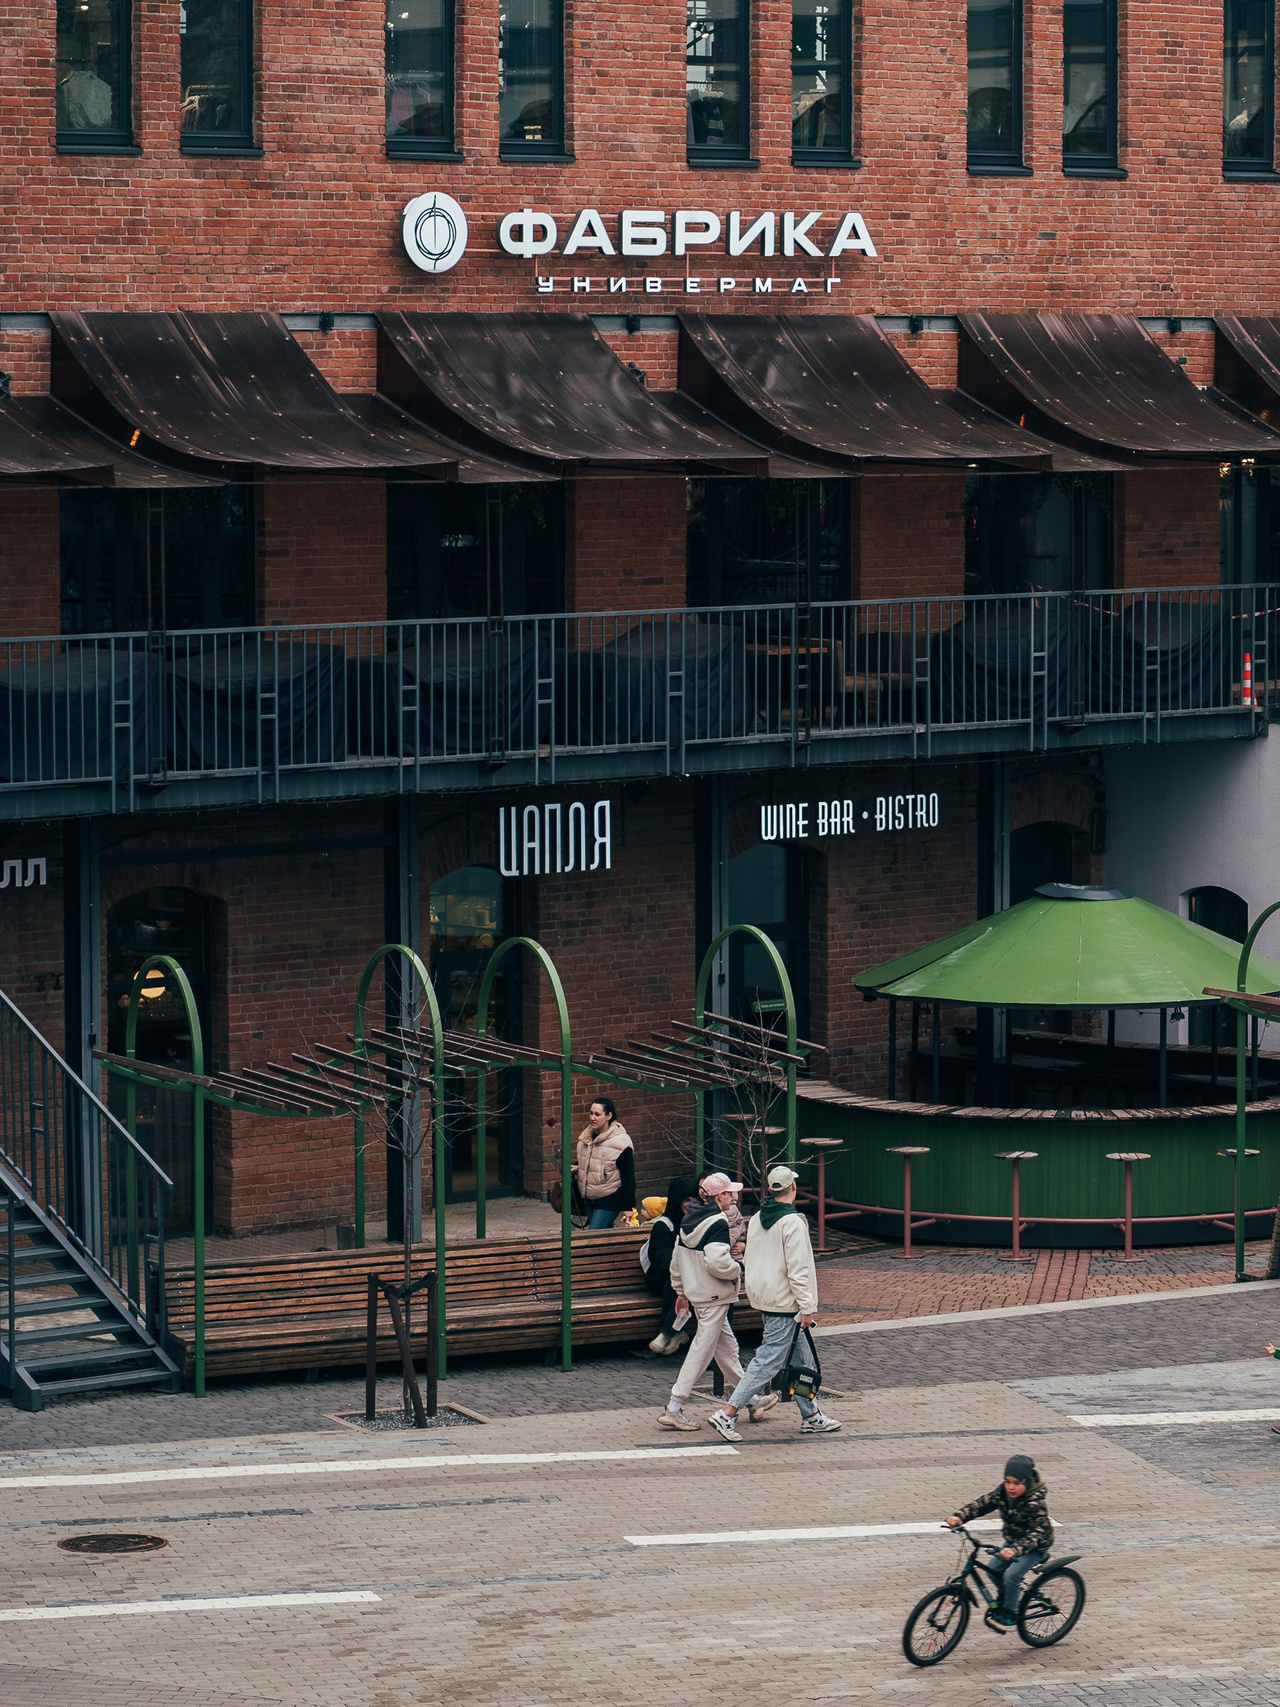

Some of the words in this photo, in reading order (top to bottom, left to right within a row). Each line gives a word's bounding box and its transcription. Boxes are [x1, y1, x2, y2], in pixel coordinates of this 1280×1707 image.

[499, 208, 878, 258] ФАБРИКА
[536, 275, 842, 294] УНИВЕРМАГ
[498, 799, 612, 877] ЦАПЛЯ
[760, 802, 809, 841] WINE
[816, 799, 856, 836] BAR
[874, 792, 939, 832] BISTRO
